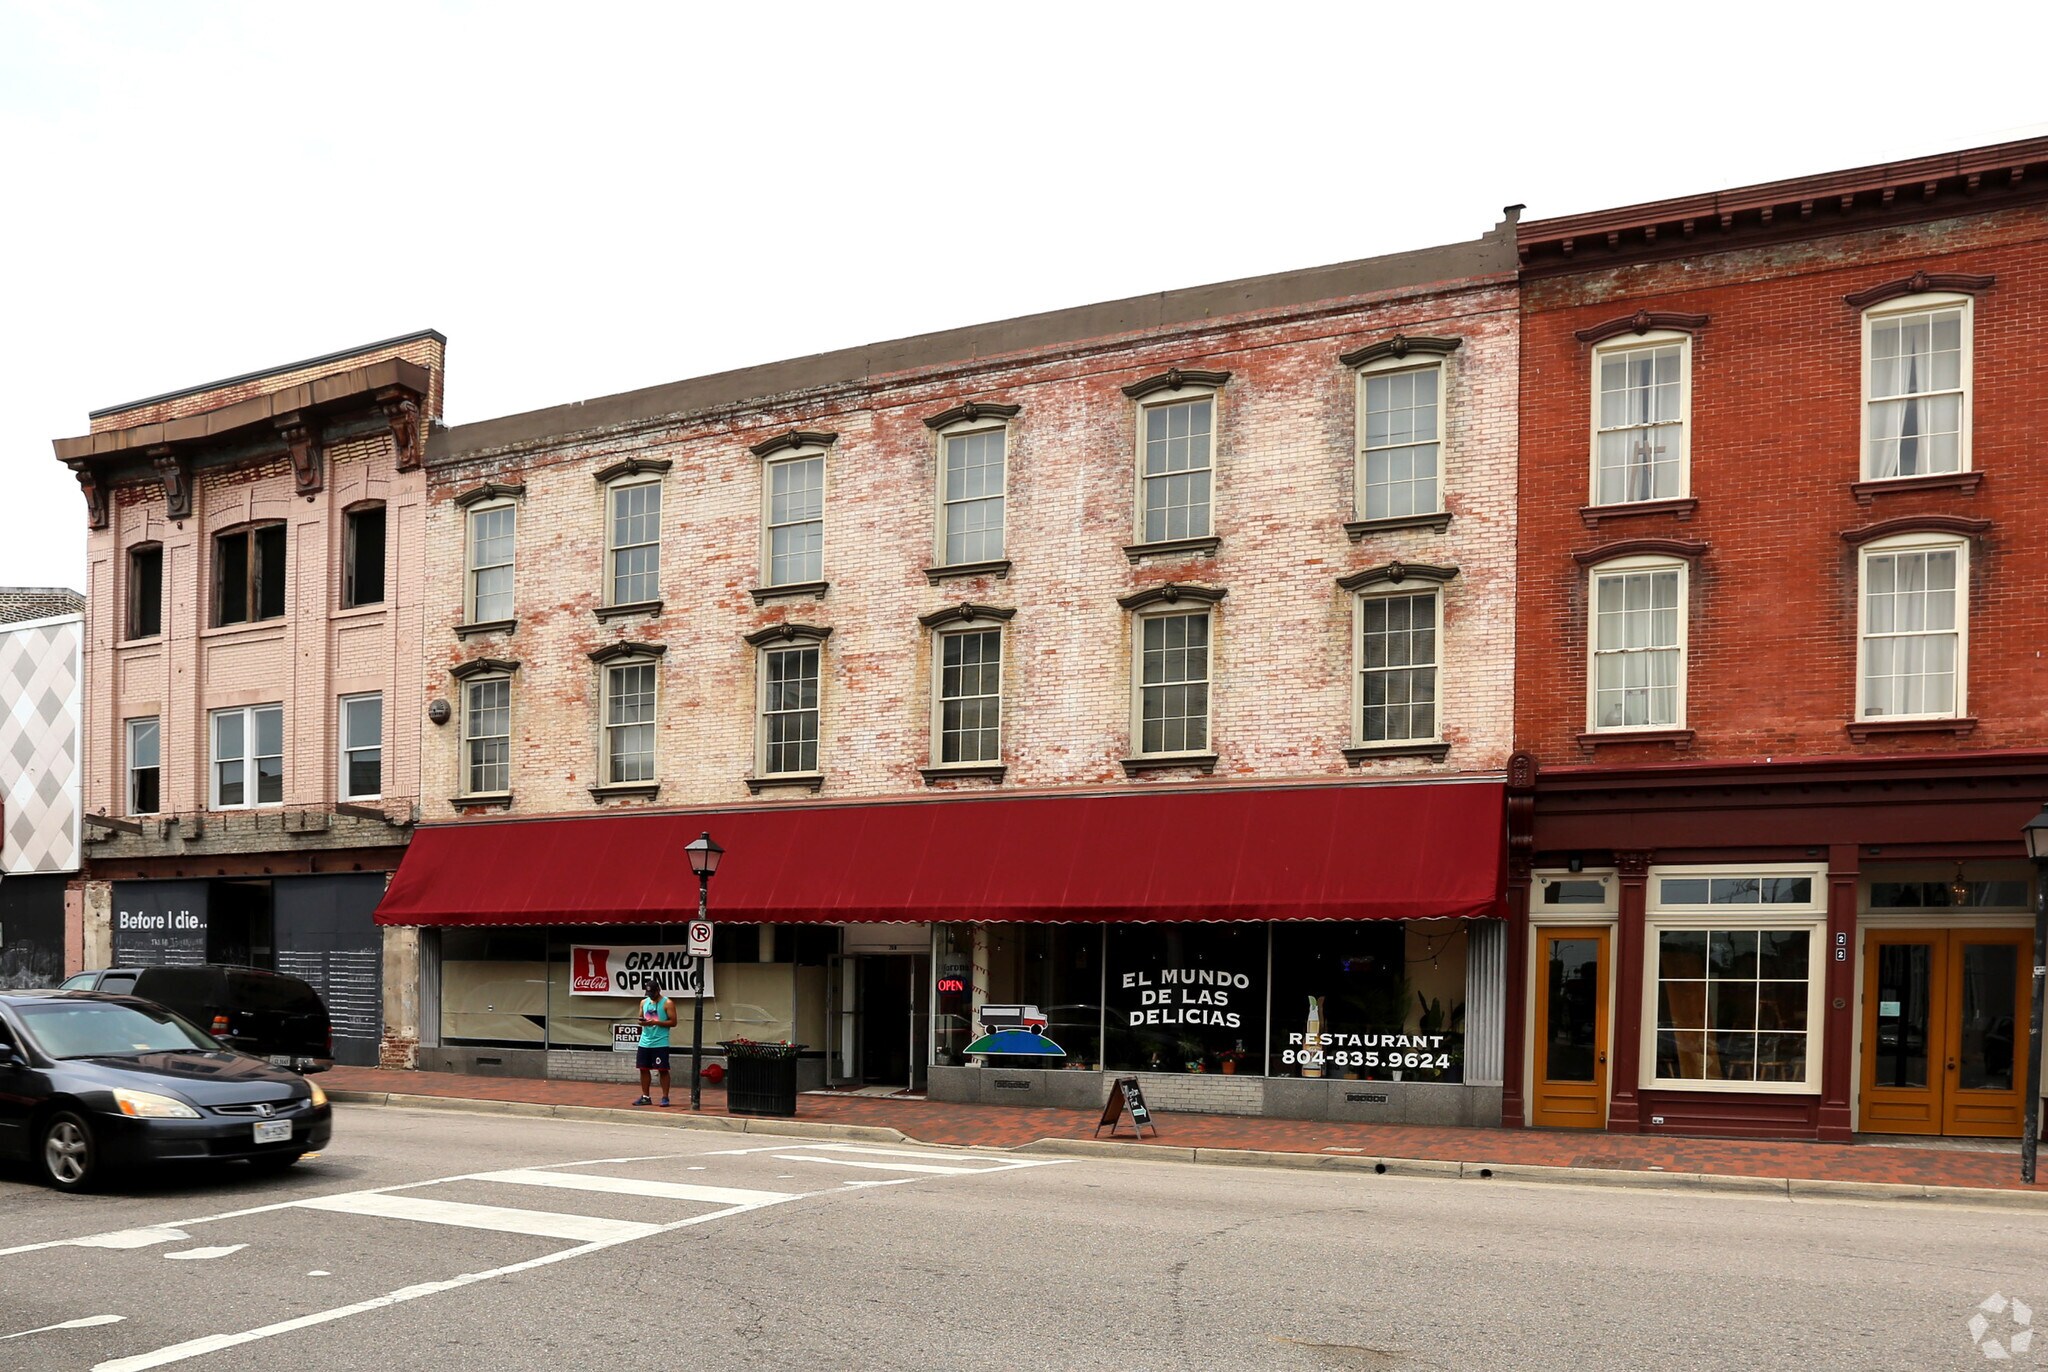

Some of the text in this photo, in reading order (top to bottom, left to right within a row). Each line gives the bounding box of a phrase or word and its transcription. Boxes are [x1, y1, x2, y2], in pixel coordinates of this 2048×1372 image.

[119, 911, 165, 929] Before
[168, 911, 173, 929] I
[625, 952, 693, 971] GRAND
[937, 979, 963, 992] OPEN
[1122, 969, 1250, 989] EL MUNDO
[1141, 989, 1229, 1006] DE LAS
[1129, 1008, 1241, 1028] DELICIAS
[615, 1034, 640, 1042] RENT
[618, 1026, 638, 1035] FOR
[1289, 1032, 1444, 1048] RESTAURANT
[1282, 1049, 1450, 1069] 804-835.9624
